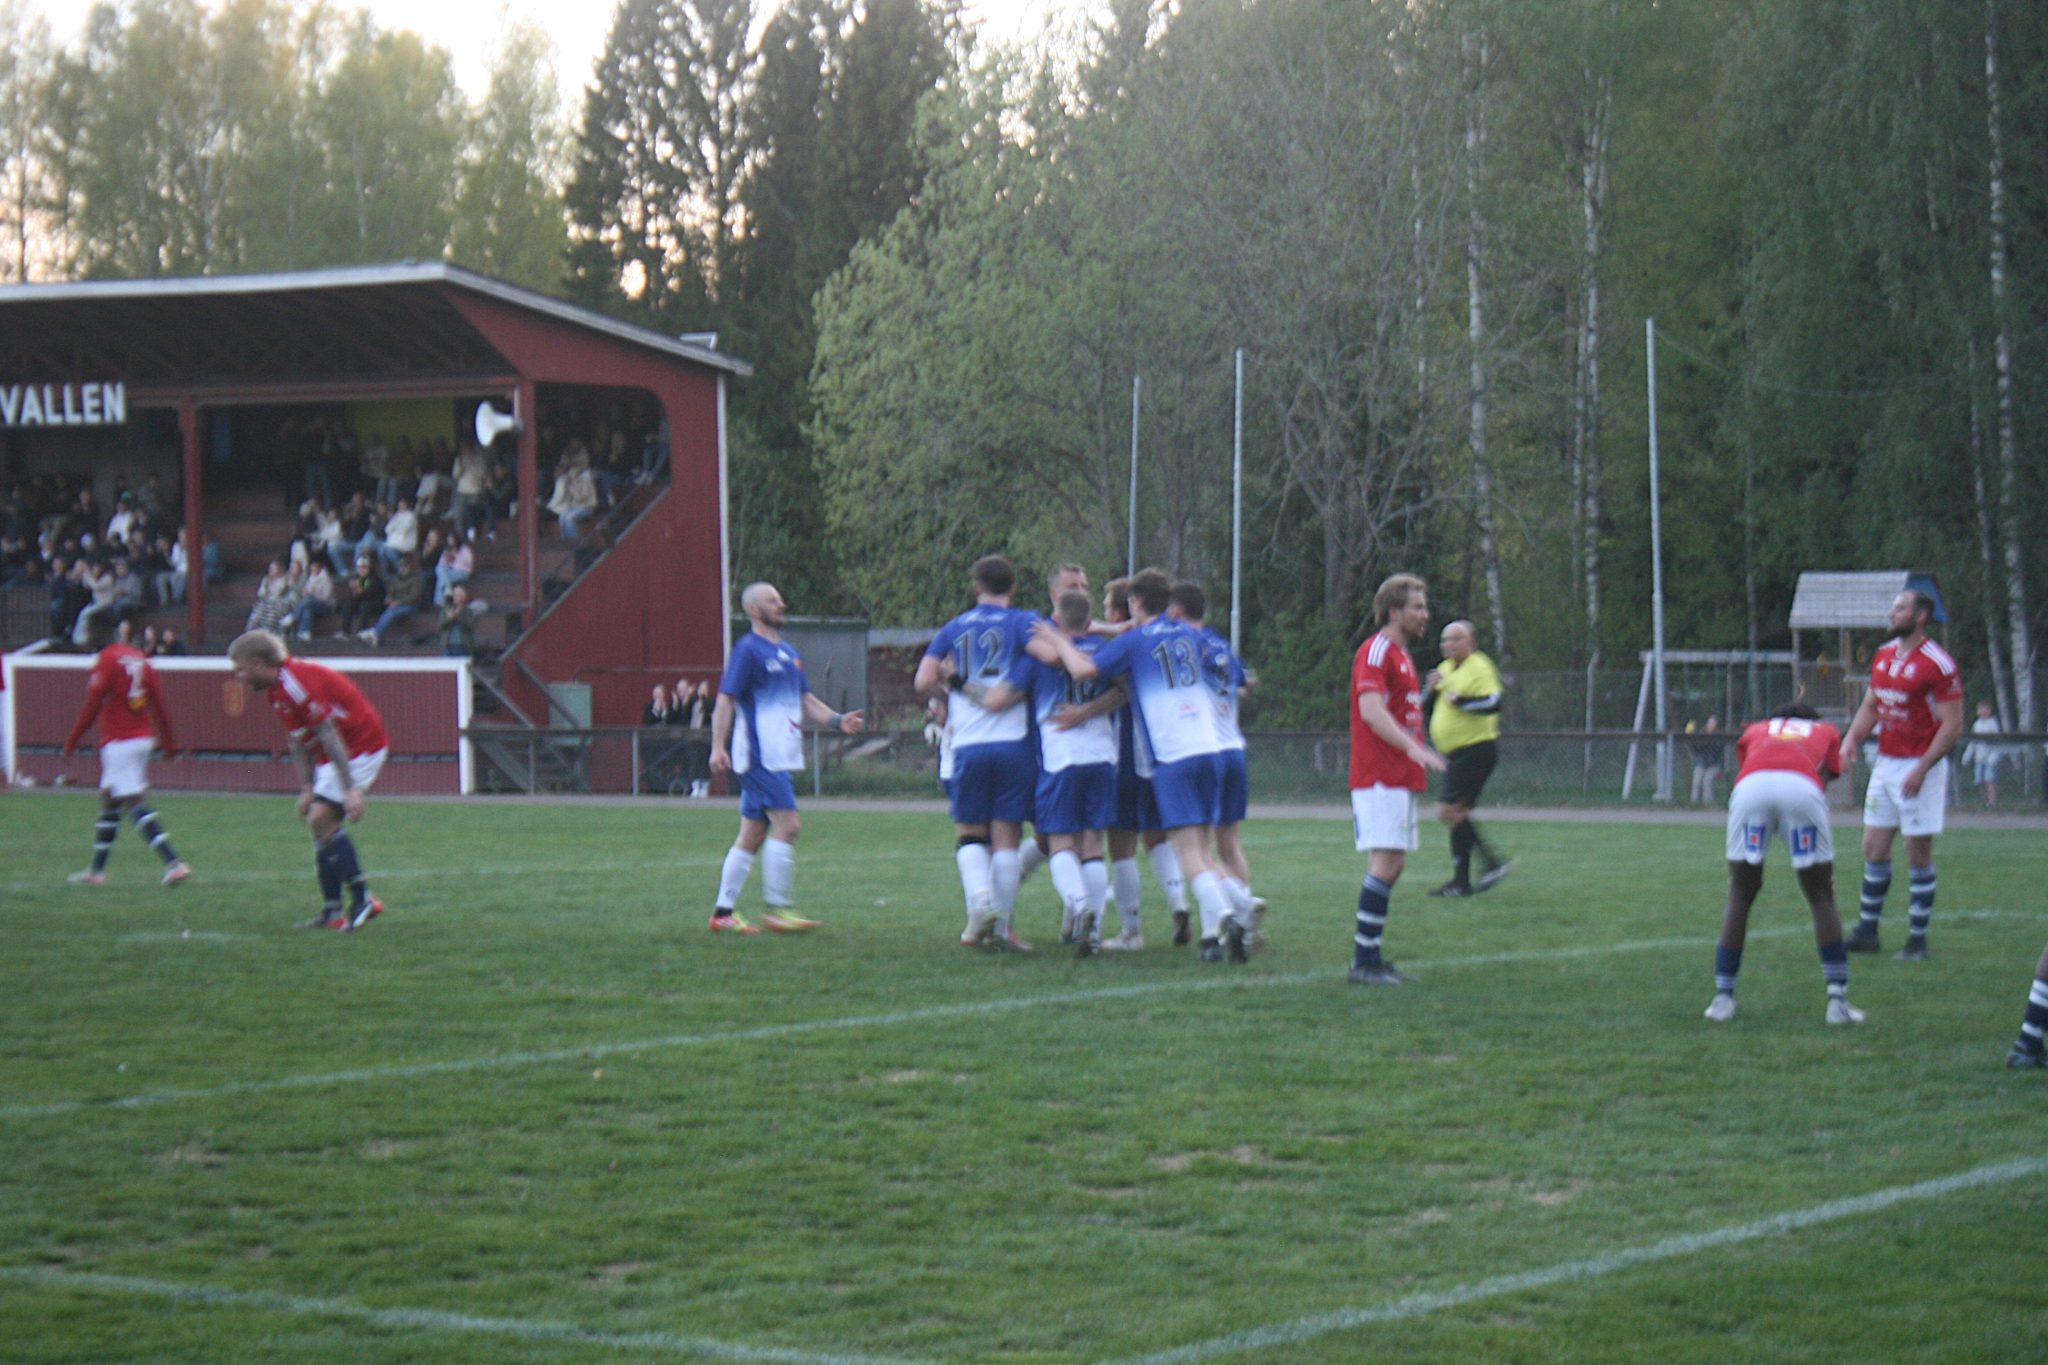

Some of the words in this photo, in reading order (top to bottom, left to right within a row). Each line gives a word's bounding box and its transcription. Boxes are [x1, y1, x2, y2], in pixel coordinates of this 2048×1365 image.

[0, 382, 126, 425] VALLEN
[953, 626, 1006, 683] 12
[1151, 638, 1198, 690] 13
